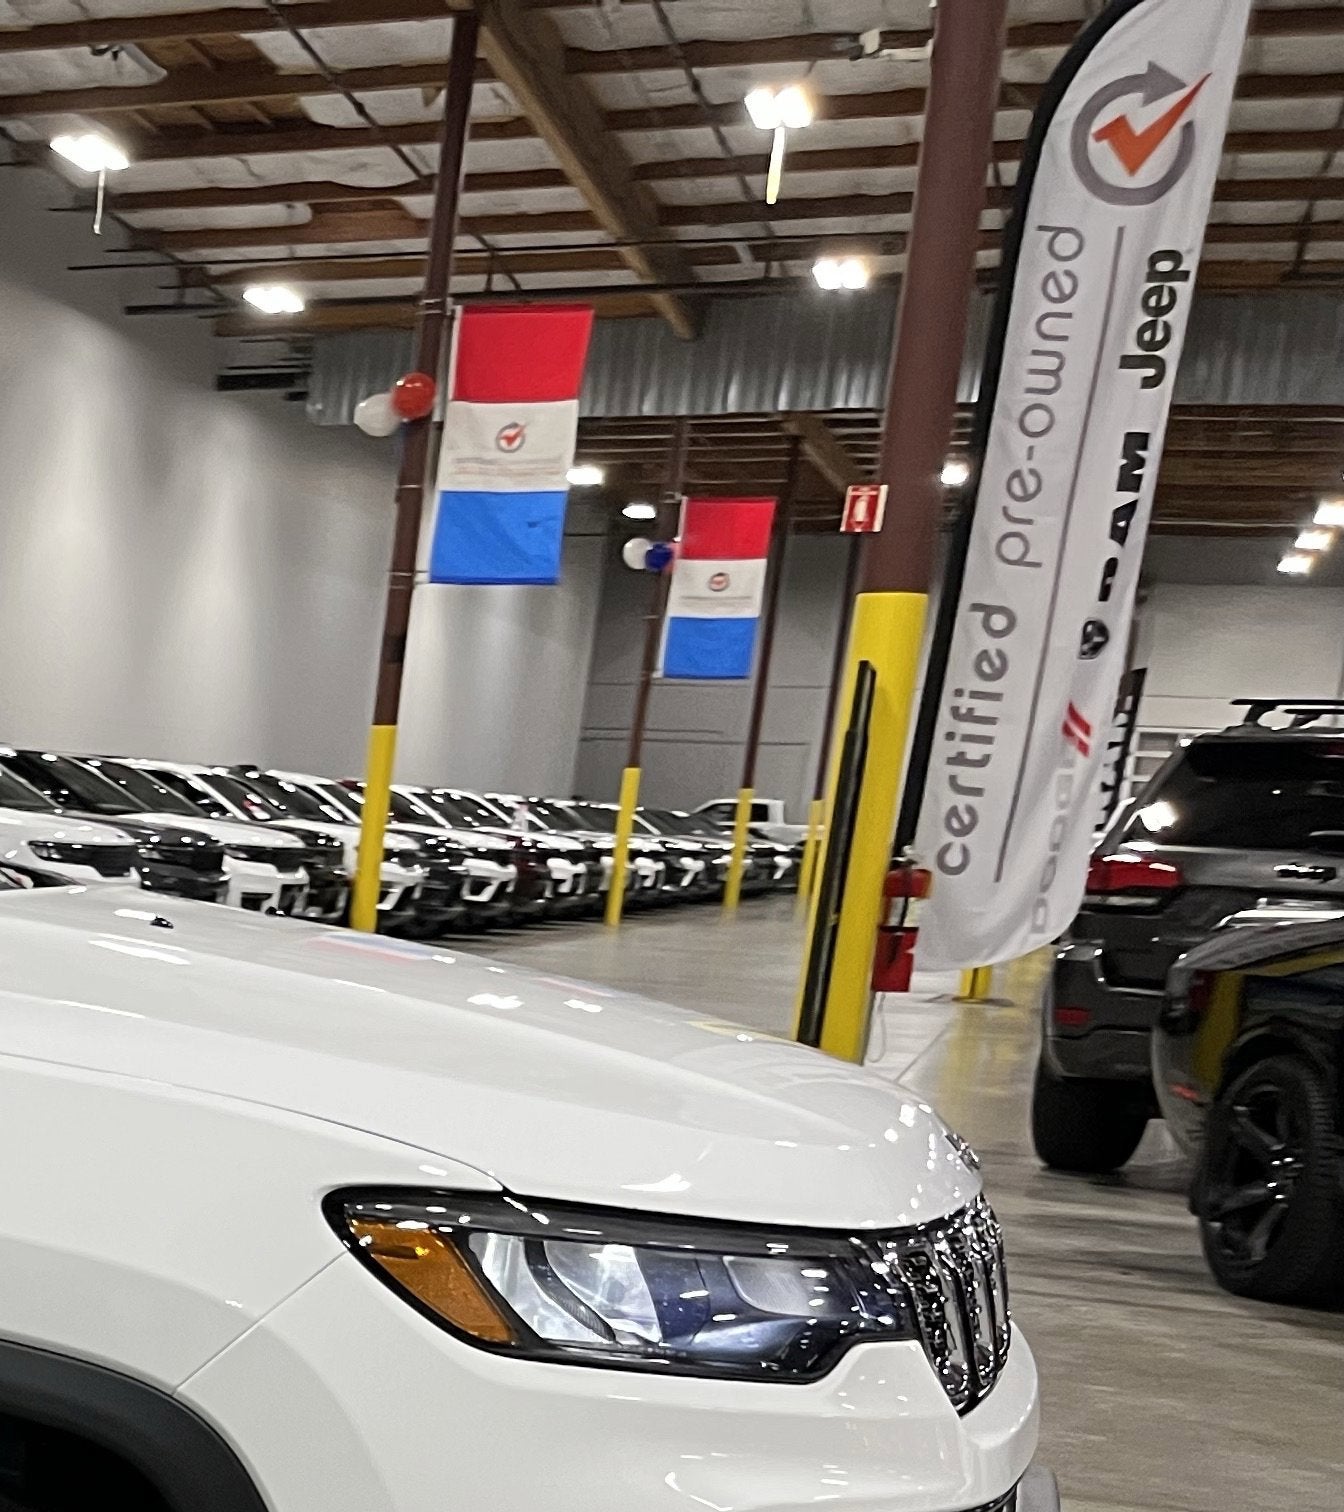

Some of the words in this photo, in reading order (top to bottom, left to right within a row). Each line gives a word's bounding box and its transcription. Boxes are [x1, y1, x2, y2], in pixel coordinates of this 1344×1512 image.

[1118, 249, 1191, 390] Jeep
[936, 602, 1017, 876] certified
[995, 225, 1085, 568] pre-owned
